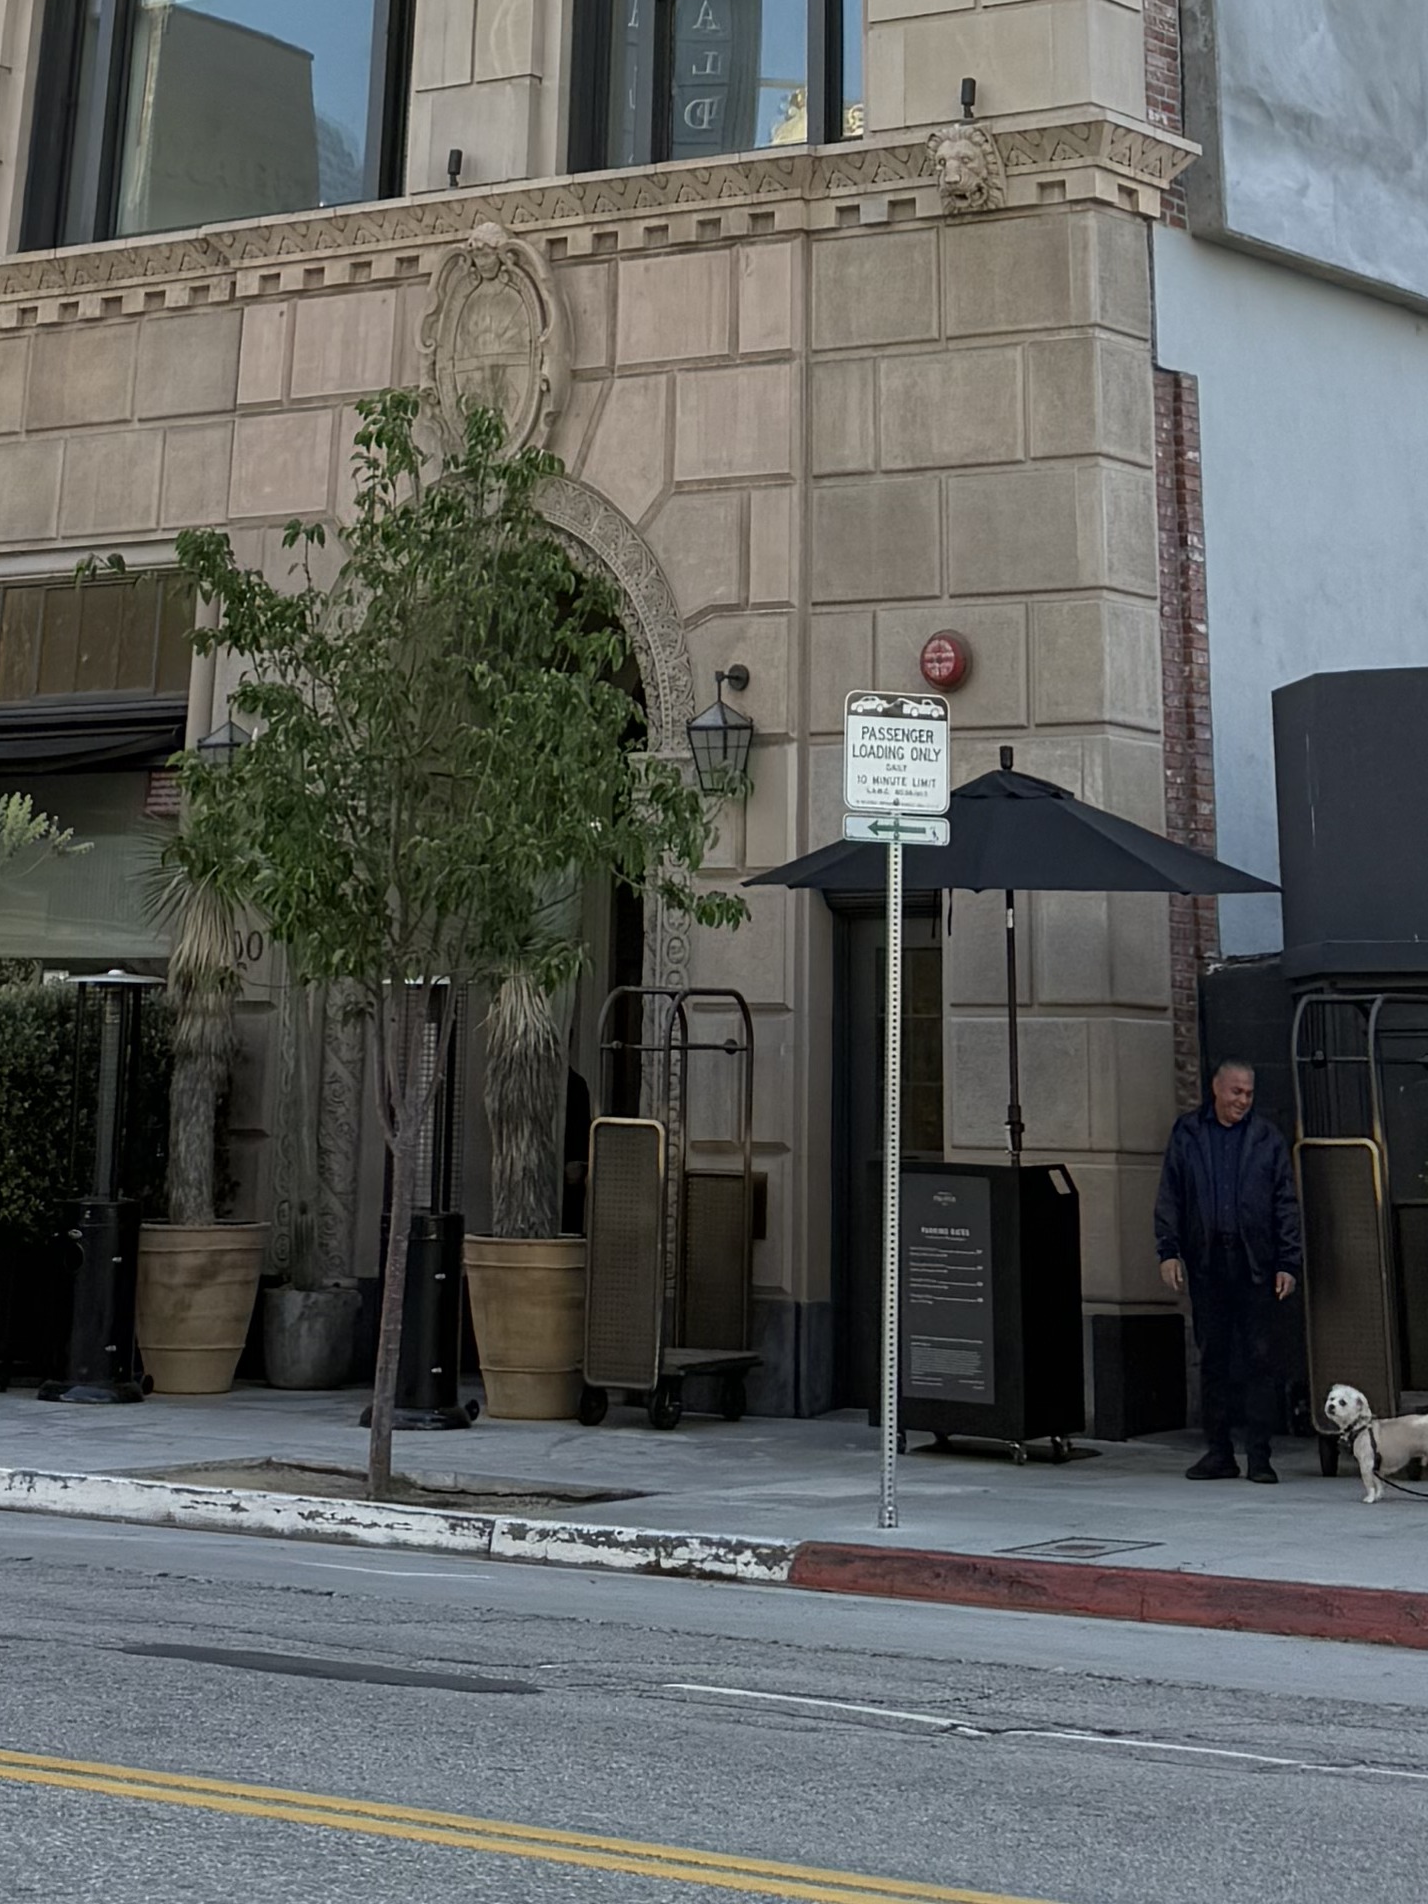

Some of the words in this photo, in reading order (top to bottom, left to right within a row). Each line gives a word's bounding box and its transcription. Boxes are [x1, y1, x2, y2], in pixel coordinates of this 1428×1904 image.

[861, 725, 935, 744] PASSENGER
[852, 743, 905, 761] LOADING
[910, 747, 942, 762] ONLY
[857, 774, 868, 784] 10
[872, 775, 908, 786] MINUTE
[912, 778, 937, 789] LIMIT
